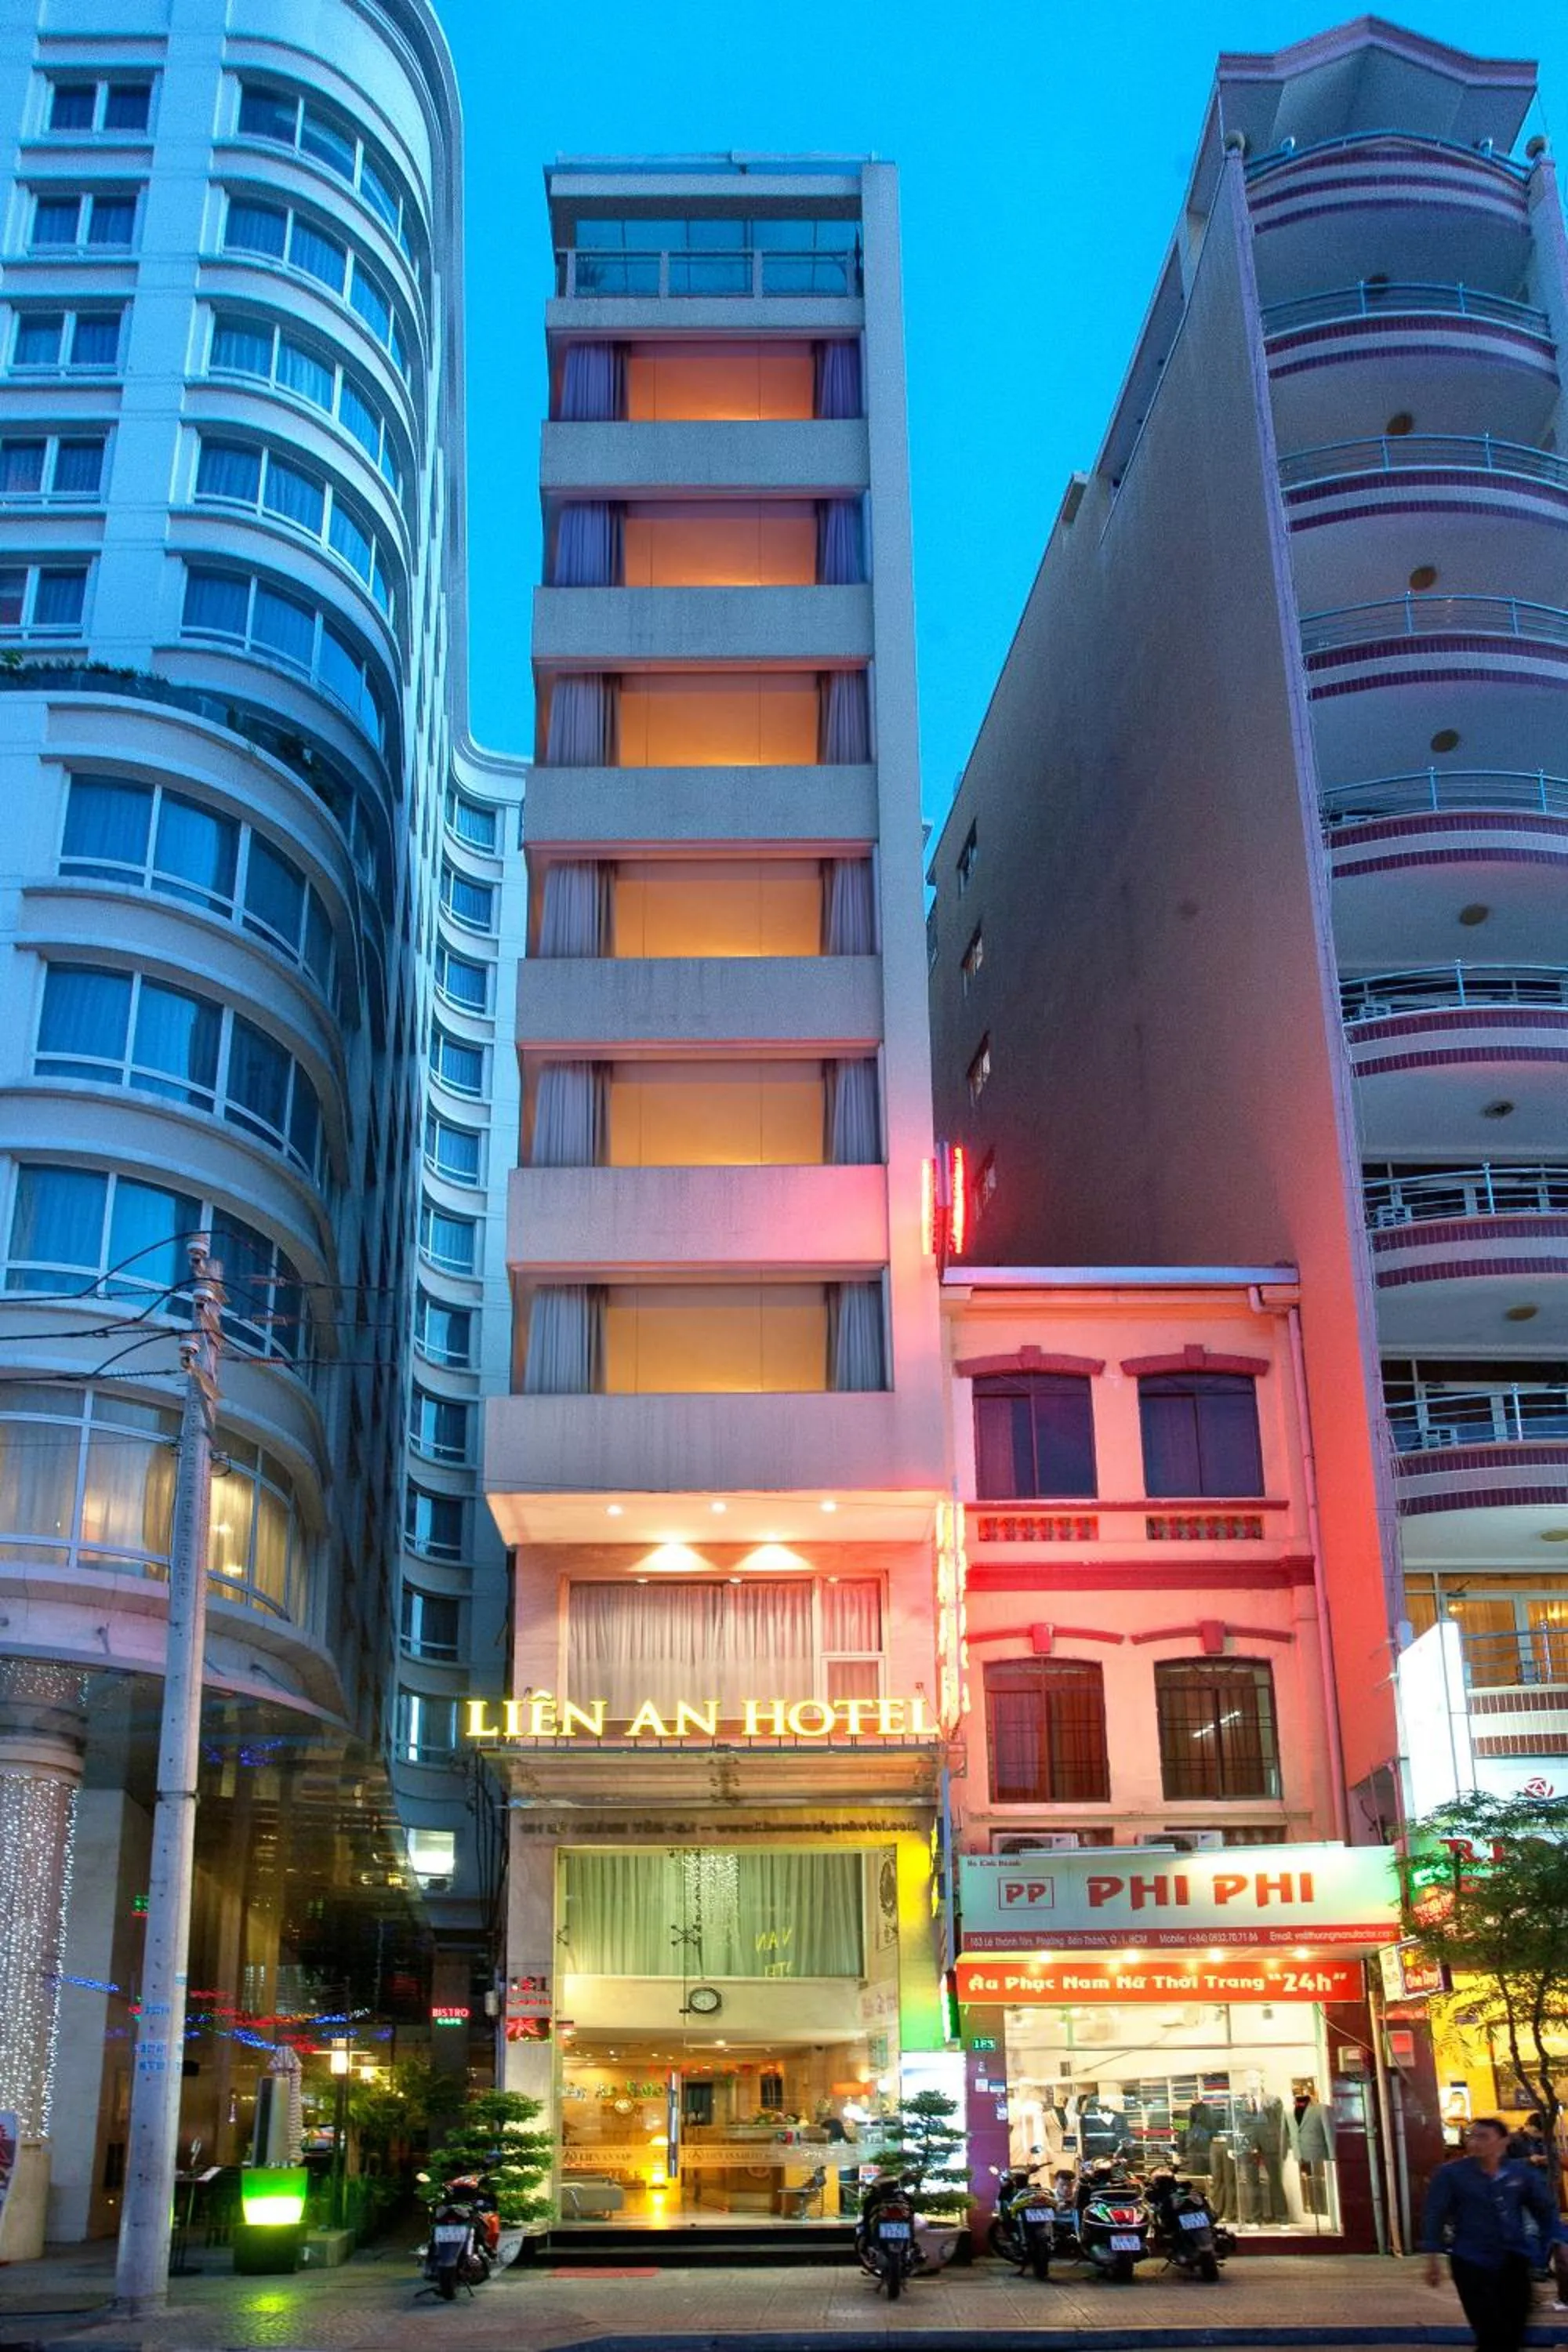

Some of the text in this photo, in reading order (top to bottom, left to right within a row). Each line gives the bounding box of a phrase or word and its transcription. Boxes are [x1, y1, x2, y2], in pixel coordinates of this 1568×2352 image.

[466, 1690, 940, 1737] LIÊN AN HOTEL
[1005, 1882, 1047, 1904] PP
[1087, 1872, 1313, 1911] PHI PHI
[1062, 1975, 1111, 1990] Nam
[1204, 1974, 1265, 1991] Trang
[432, 2007, 470, 2018] BISTRO
